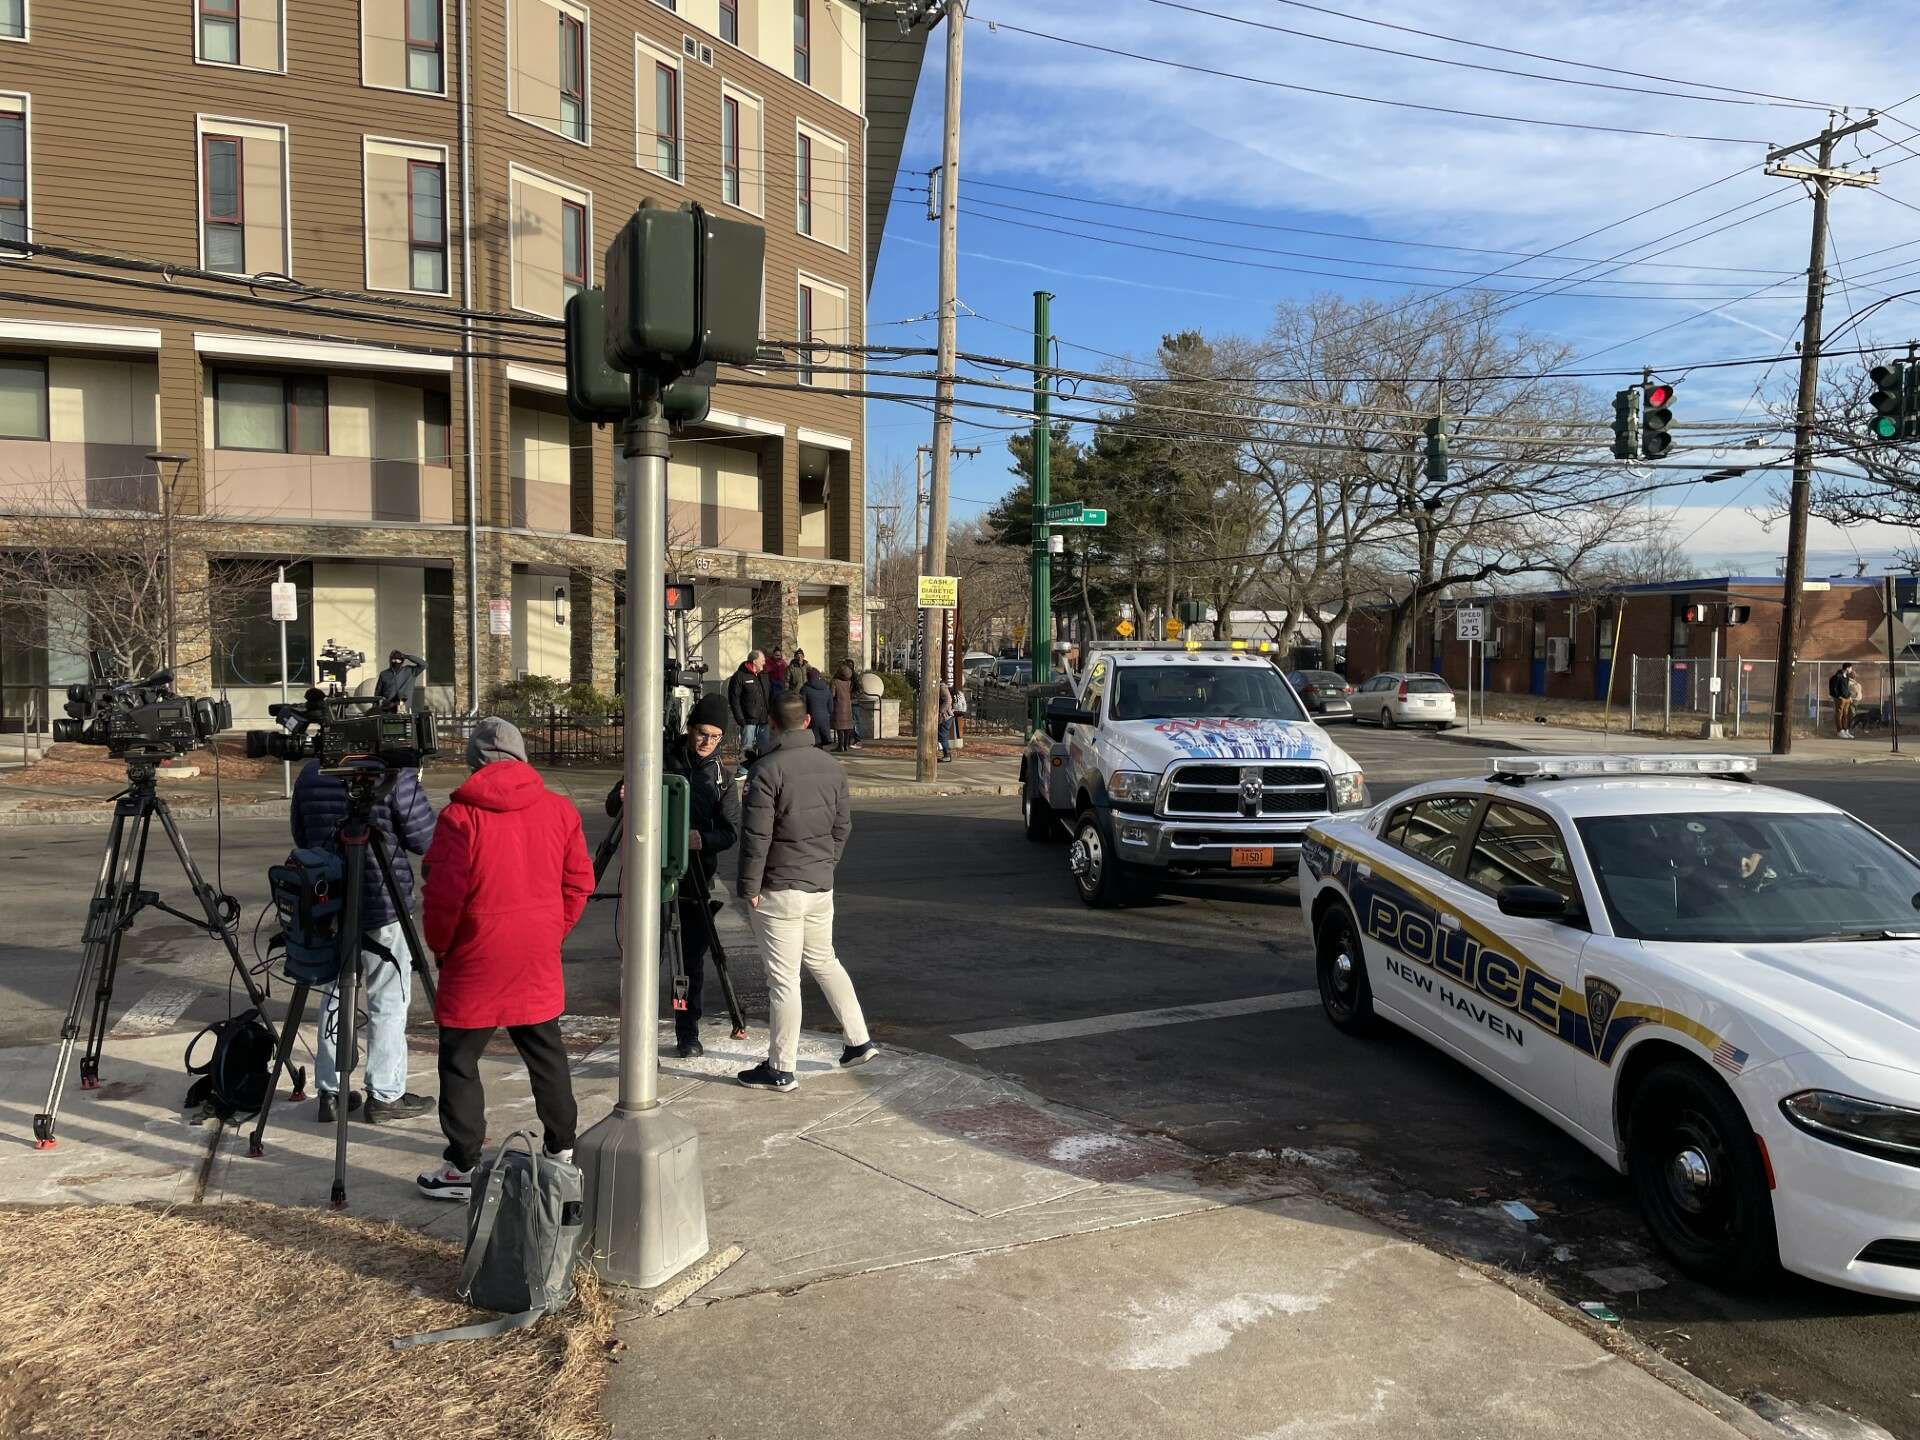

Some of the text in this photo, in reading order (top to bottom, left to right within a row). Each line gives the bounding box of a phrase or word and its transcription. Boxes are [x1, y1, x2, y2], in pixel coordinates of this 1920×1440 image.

[921, 587, 954, 595] DIABETIC
[1461, 625, 1479, 637] 25
[1368, 894, 1565, 1034] POLICE
[1386, 956, 1524, 1047] NEW HAVEN
